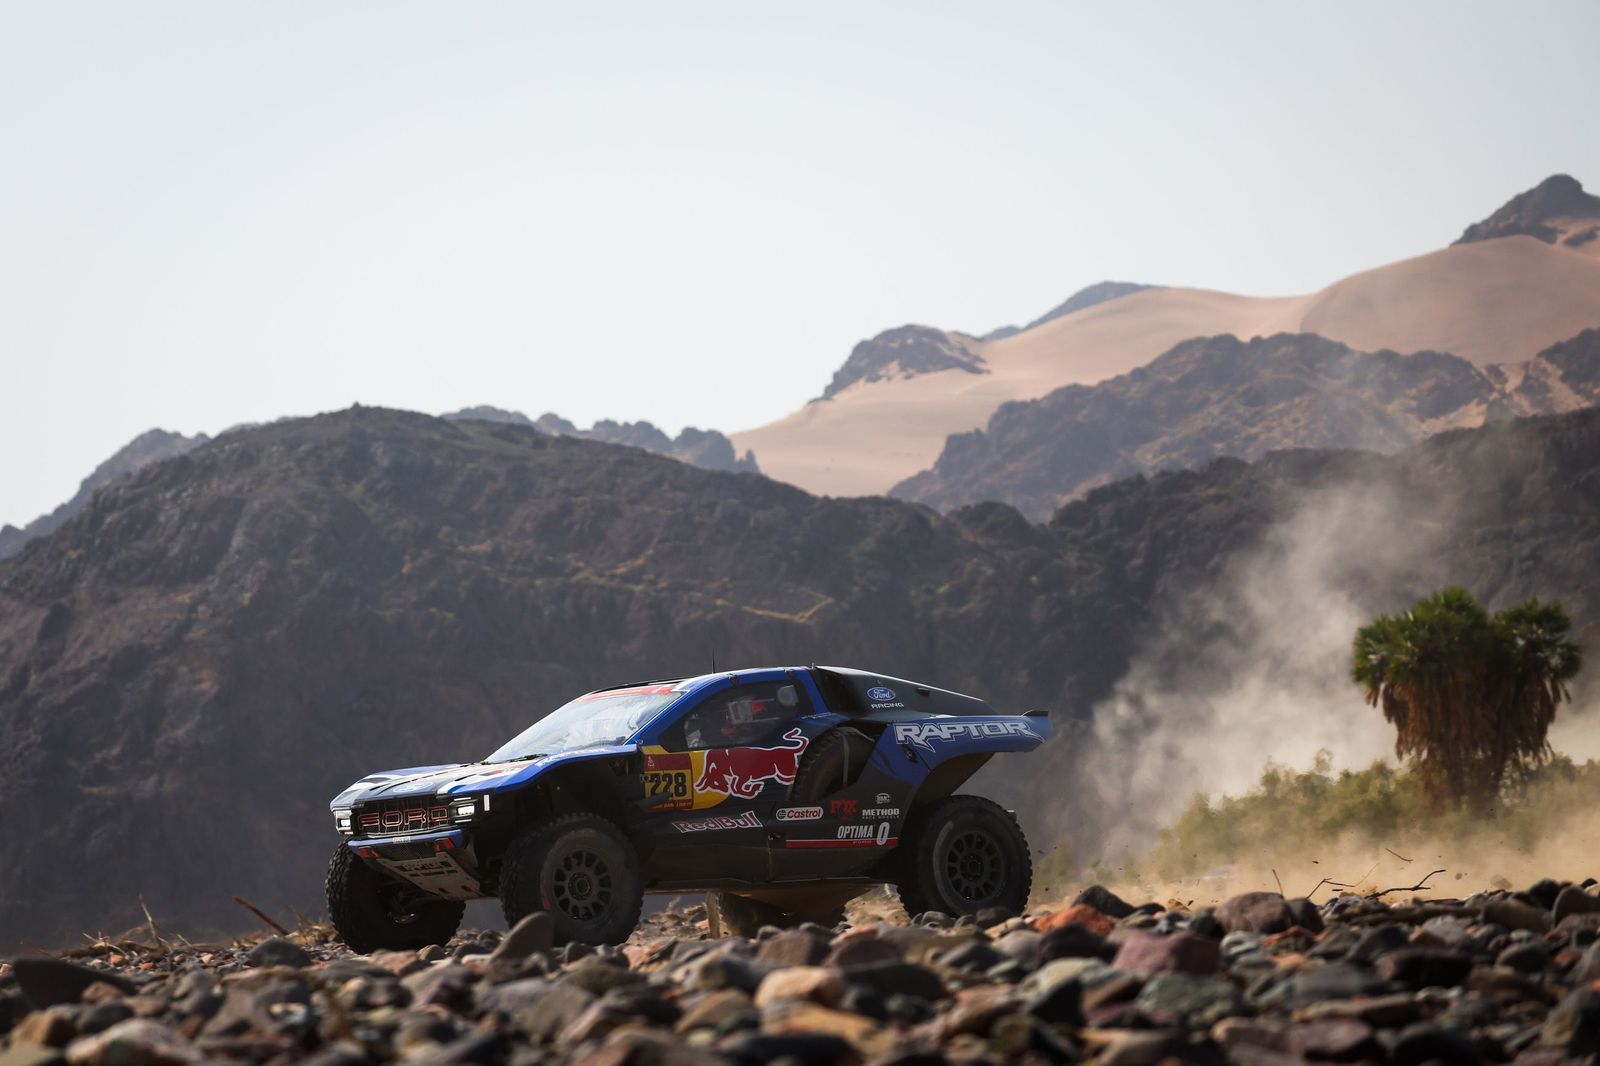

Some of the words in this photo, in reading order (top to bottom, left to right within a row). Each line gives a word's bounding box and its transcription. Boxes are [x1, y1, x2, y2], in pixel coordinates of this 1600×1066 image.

[873, 689, 891, 698] Ford
[893, 722, 1047, 752] RAPTOR
[649, 772, 687, 797] 228
[357, 805, 449, 829] FORD
[787, 808, 821, 819] Castrol
[862, 808, 900, 816] METHOD
[837, 825, 874, 839] OPTIMA
